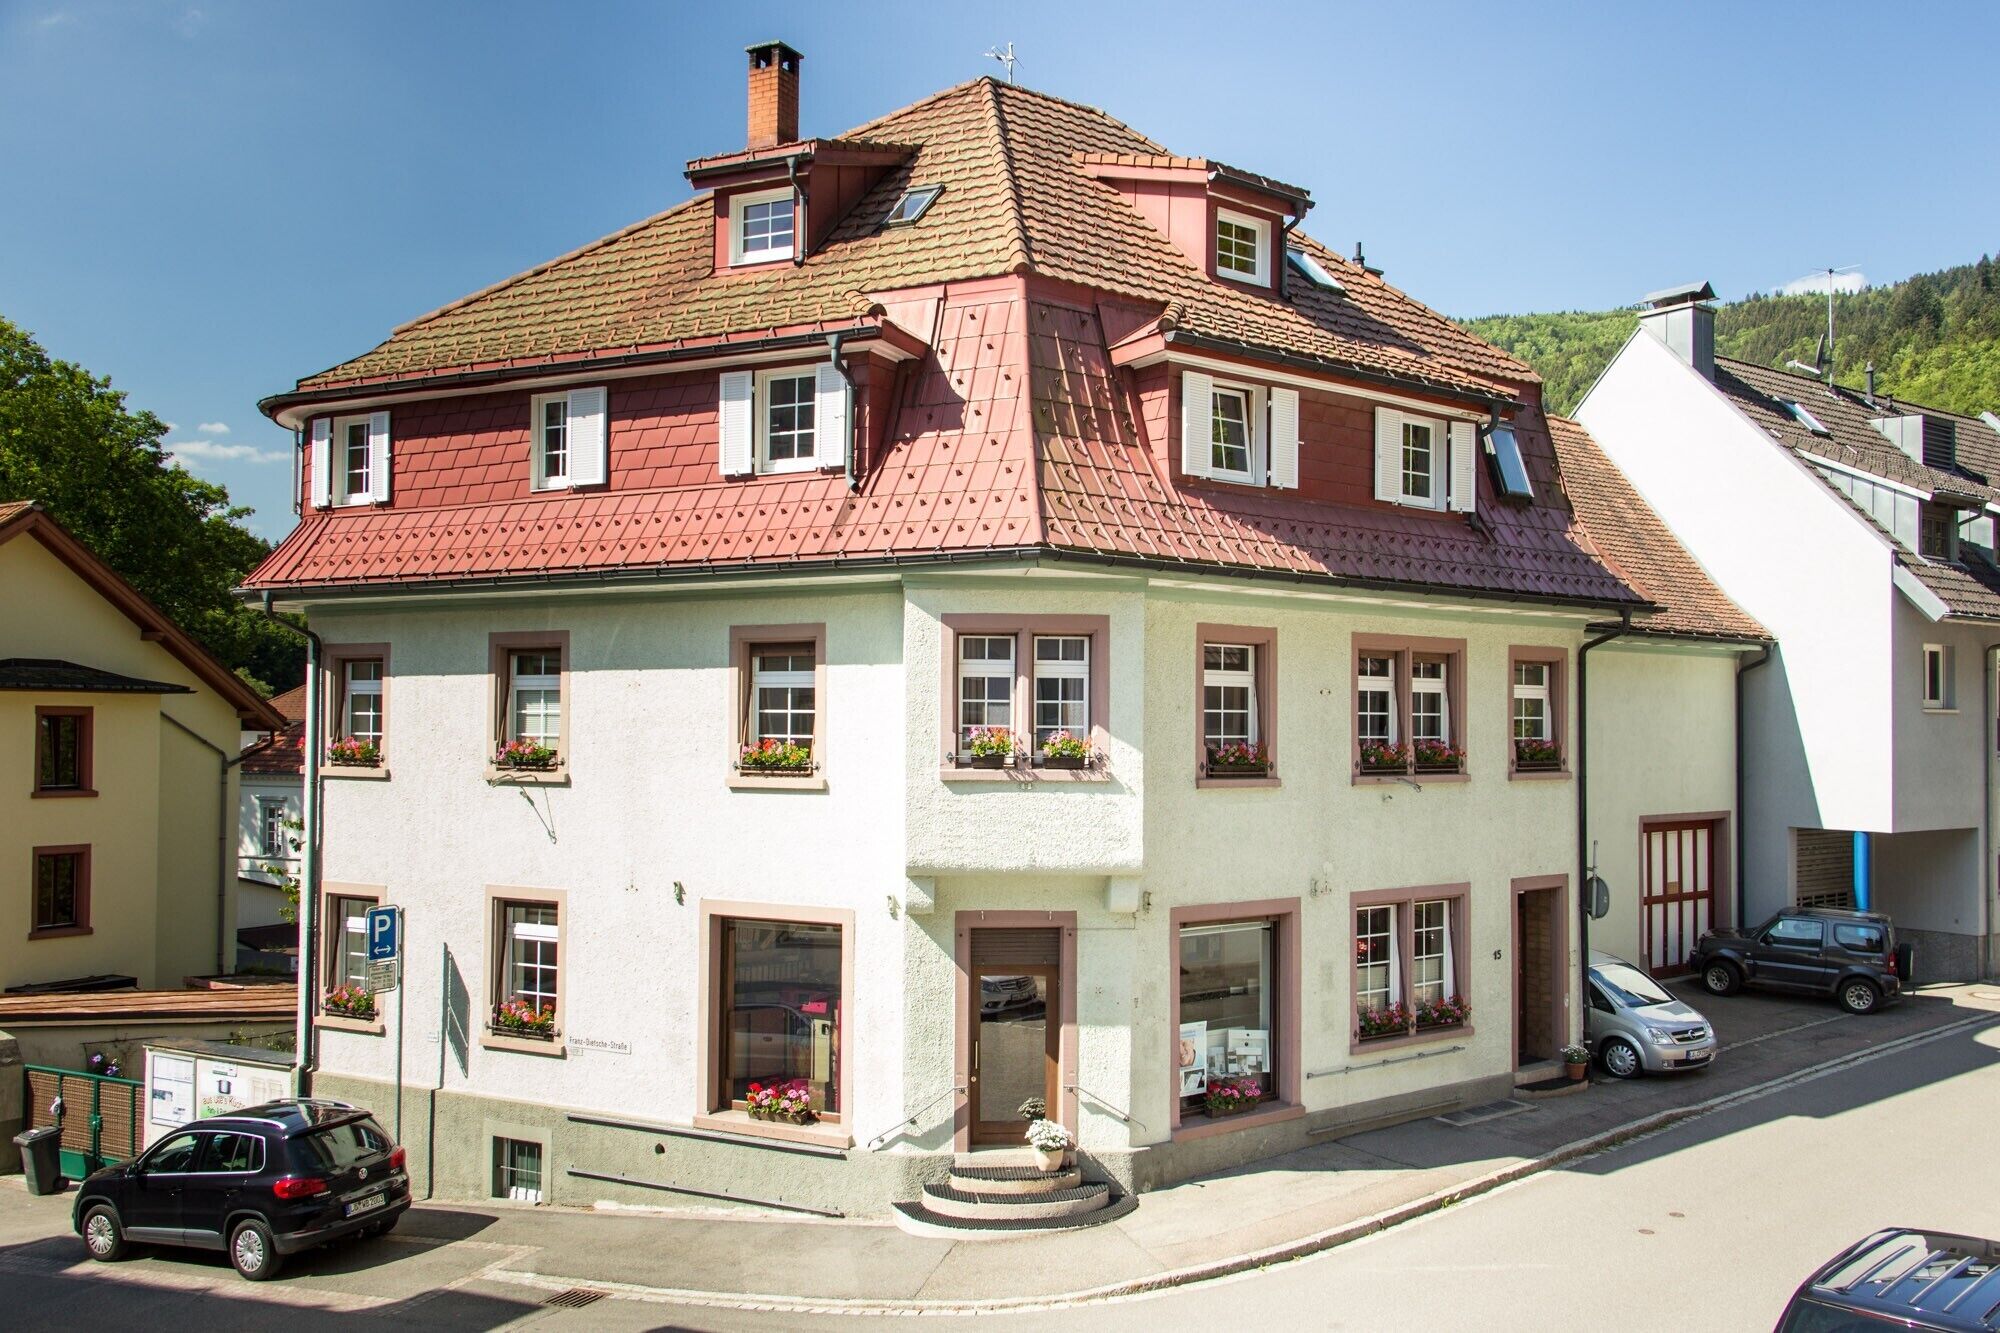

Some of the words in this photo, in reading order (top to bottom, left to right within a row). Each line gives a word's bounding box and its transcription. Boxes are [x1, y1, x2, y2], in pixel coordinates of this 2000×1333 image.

[374, 914, 391, 943] P
[1493, 949, 1502, 961] 15
[569, 1036, 627, 1050] Franz-Dietsche-Straße
